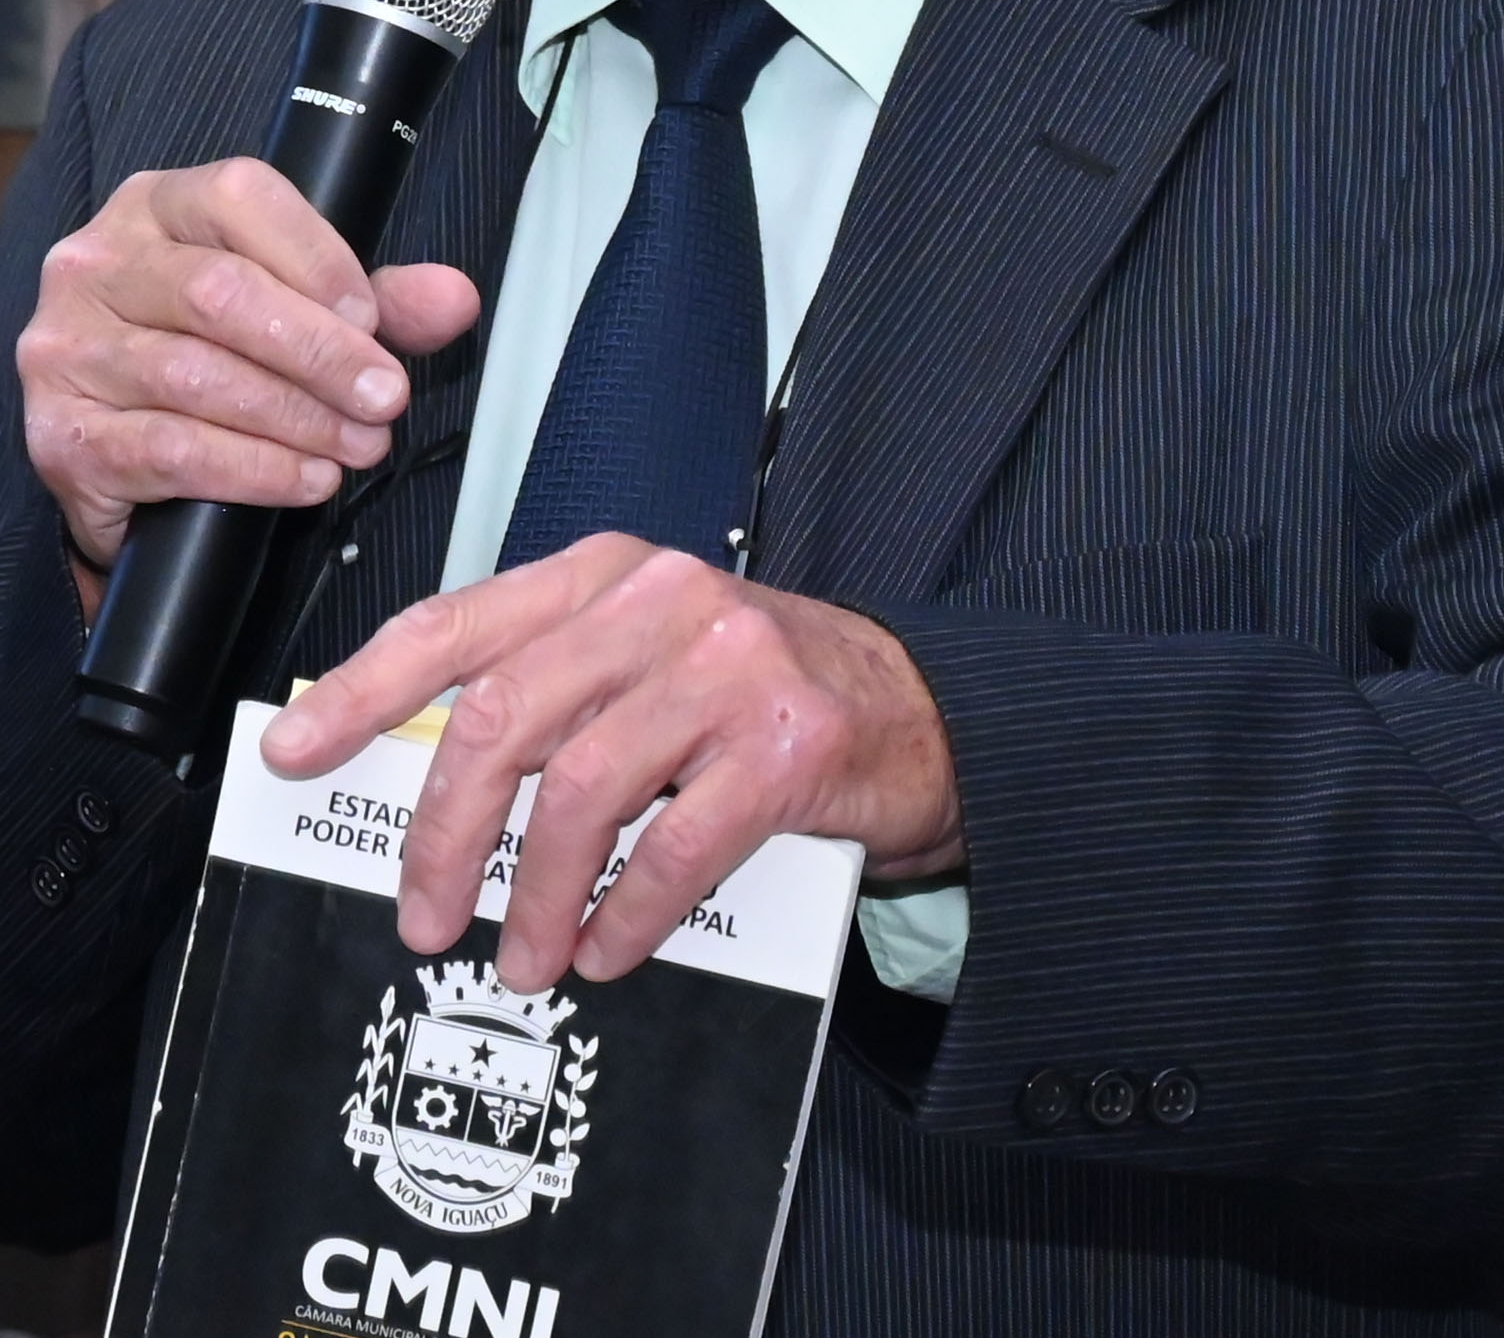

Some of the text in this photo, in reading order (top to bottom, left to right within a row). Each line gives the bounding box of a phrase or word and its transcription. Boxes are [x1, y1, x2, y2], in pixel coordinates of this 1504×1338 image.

[328, 790, 413, 830] ESTAD
[294, 815, 390, 858] PODER
[351, 1126, 385, 1147] 1833
[535, 1170, 568, 1190] 1891
[389, 1177, 508, 1227] NOVA IGUAÇU
[294, 1304, 352, 1330] CÂMARA
